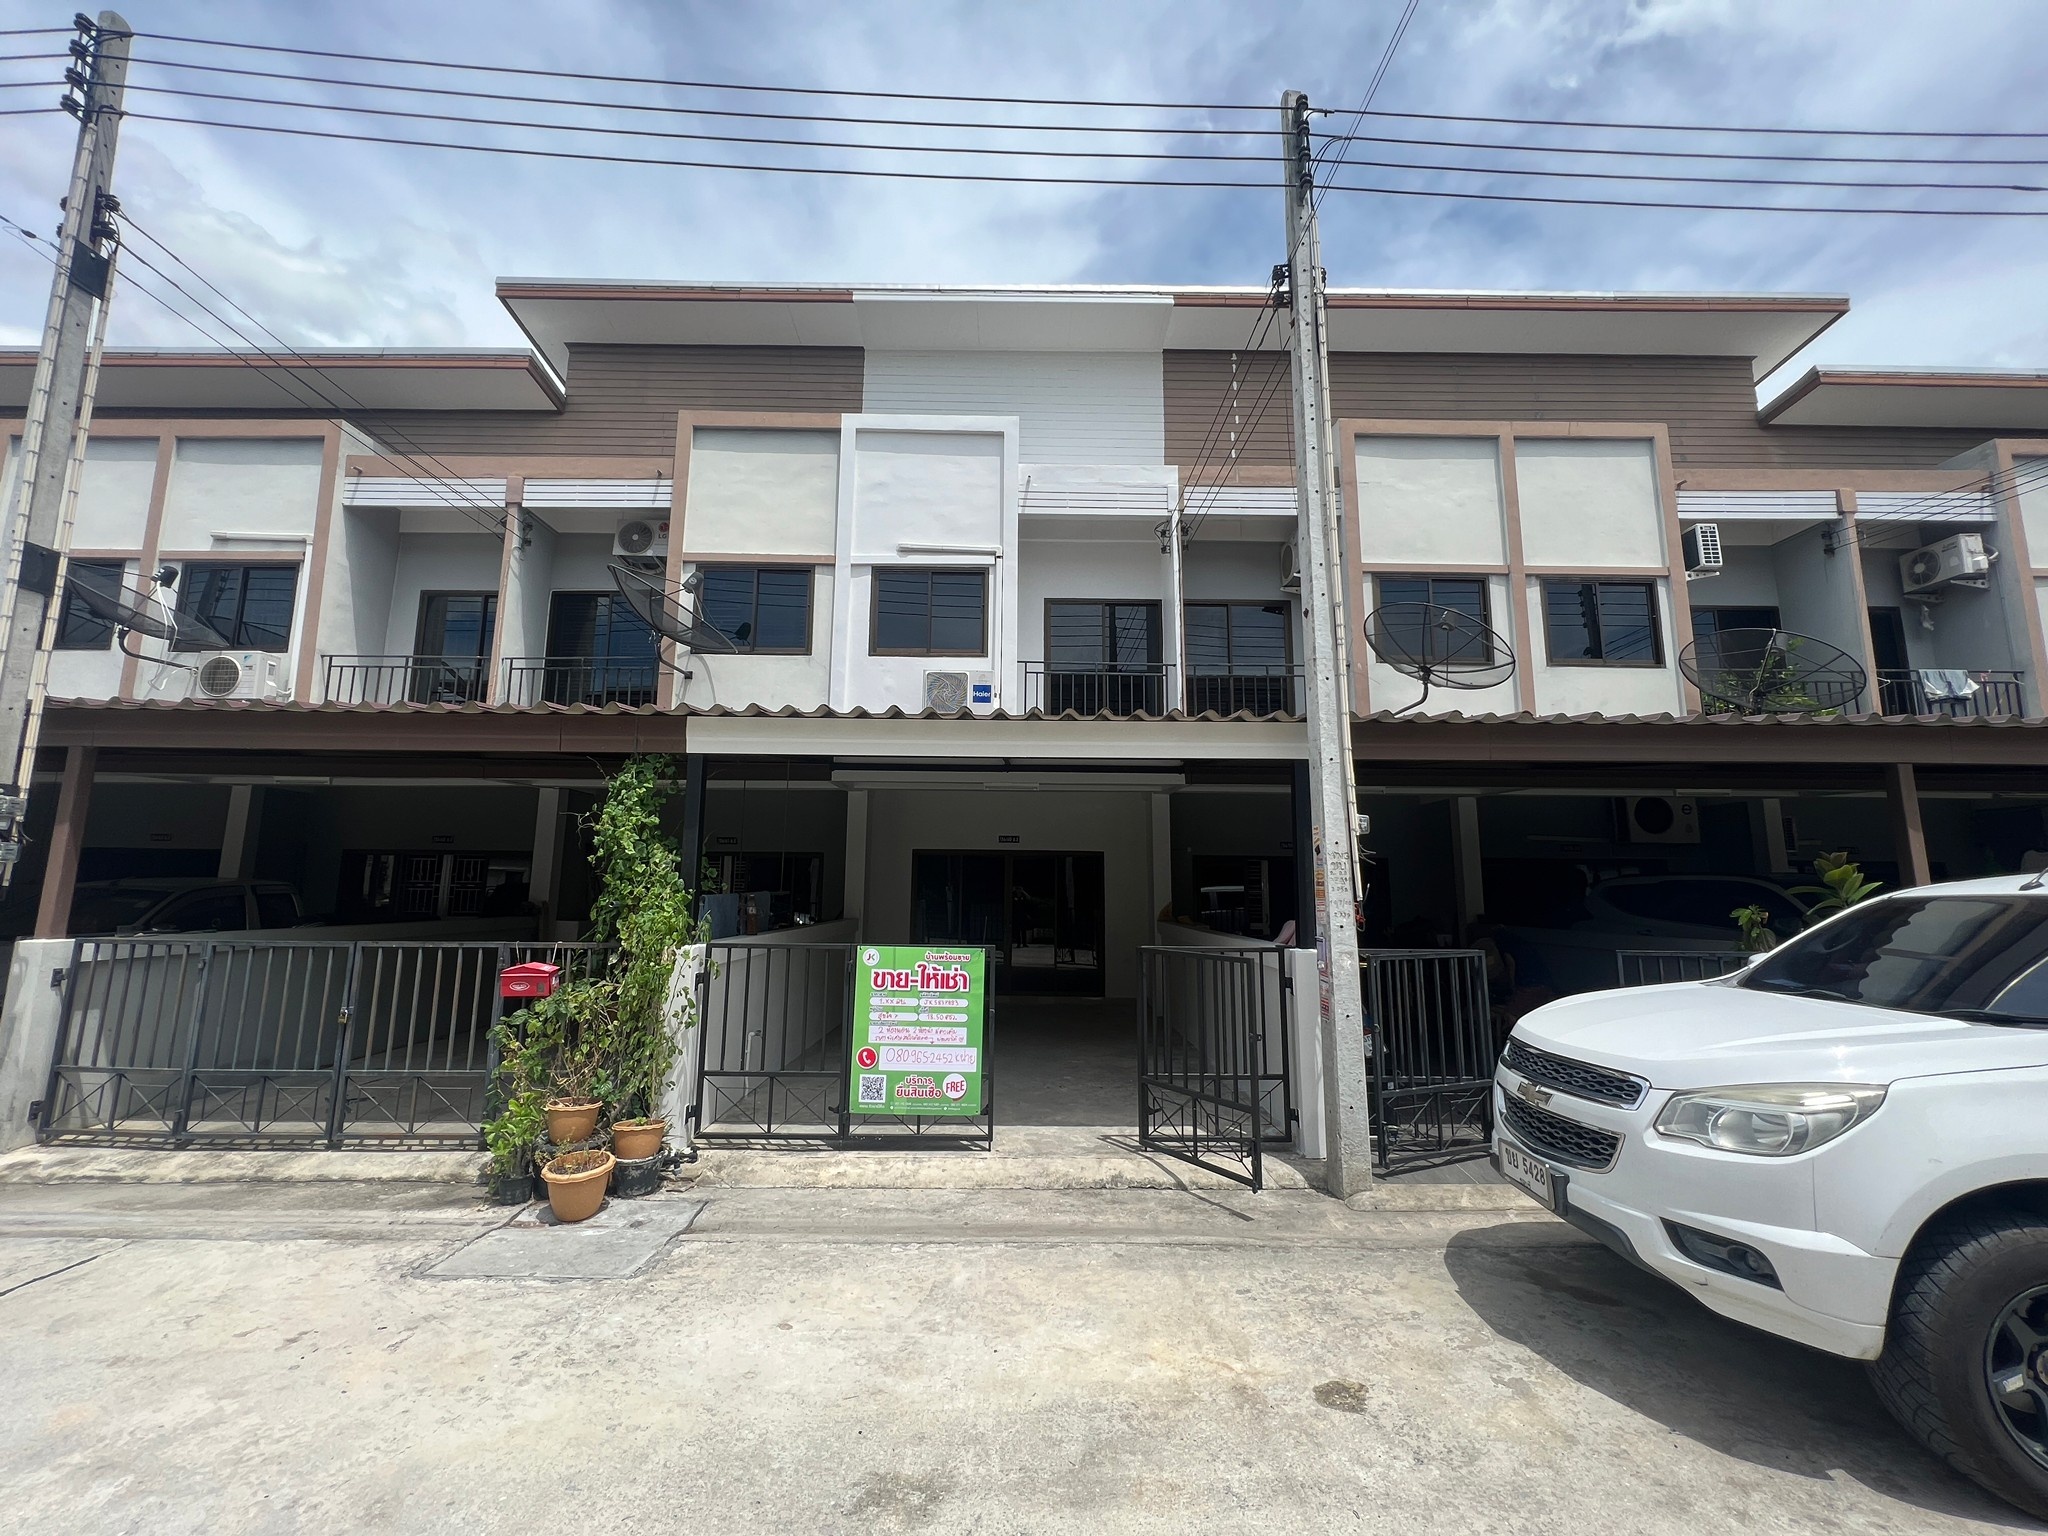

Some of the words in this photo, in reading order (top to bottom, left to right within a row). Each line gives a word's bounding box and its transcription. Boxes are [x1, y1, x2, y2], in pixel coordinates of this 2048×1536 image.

[925, 951, 970, 962] บ้านพร้อมขาย
[873, 963, 969, 990] ขาย-ให้เช่า
[905, 1076, 933, 1085] บริการ
[945, 1080, 965, 1093] FREE
[896, 1084, 942, 1098] ยื่นสินเชื่อ
[1522, 1157, 1546, 1186] 5428
